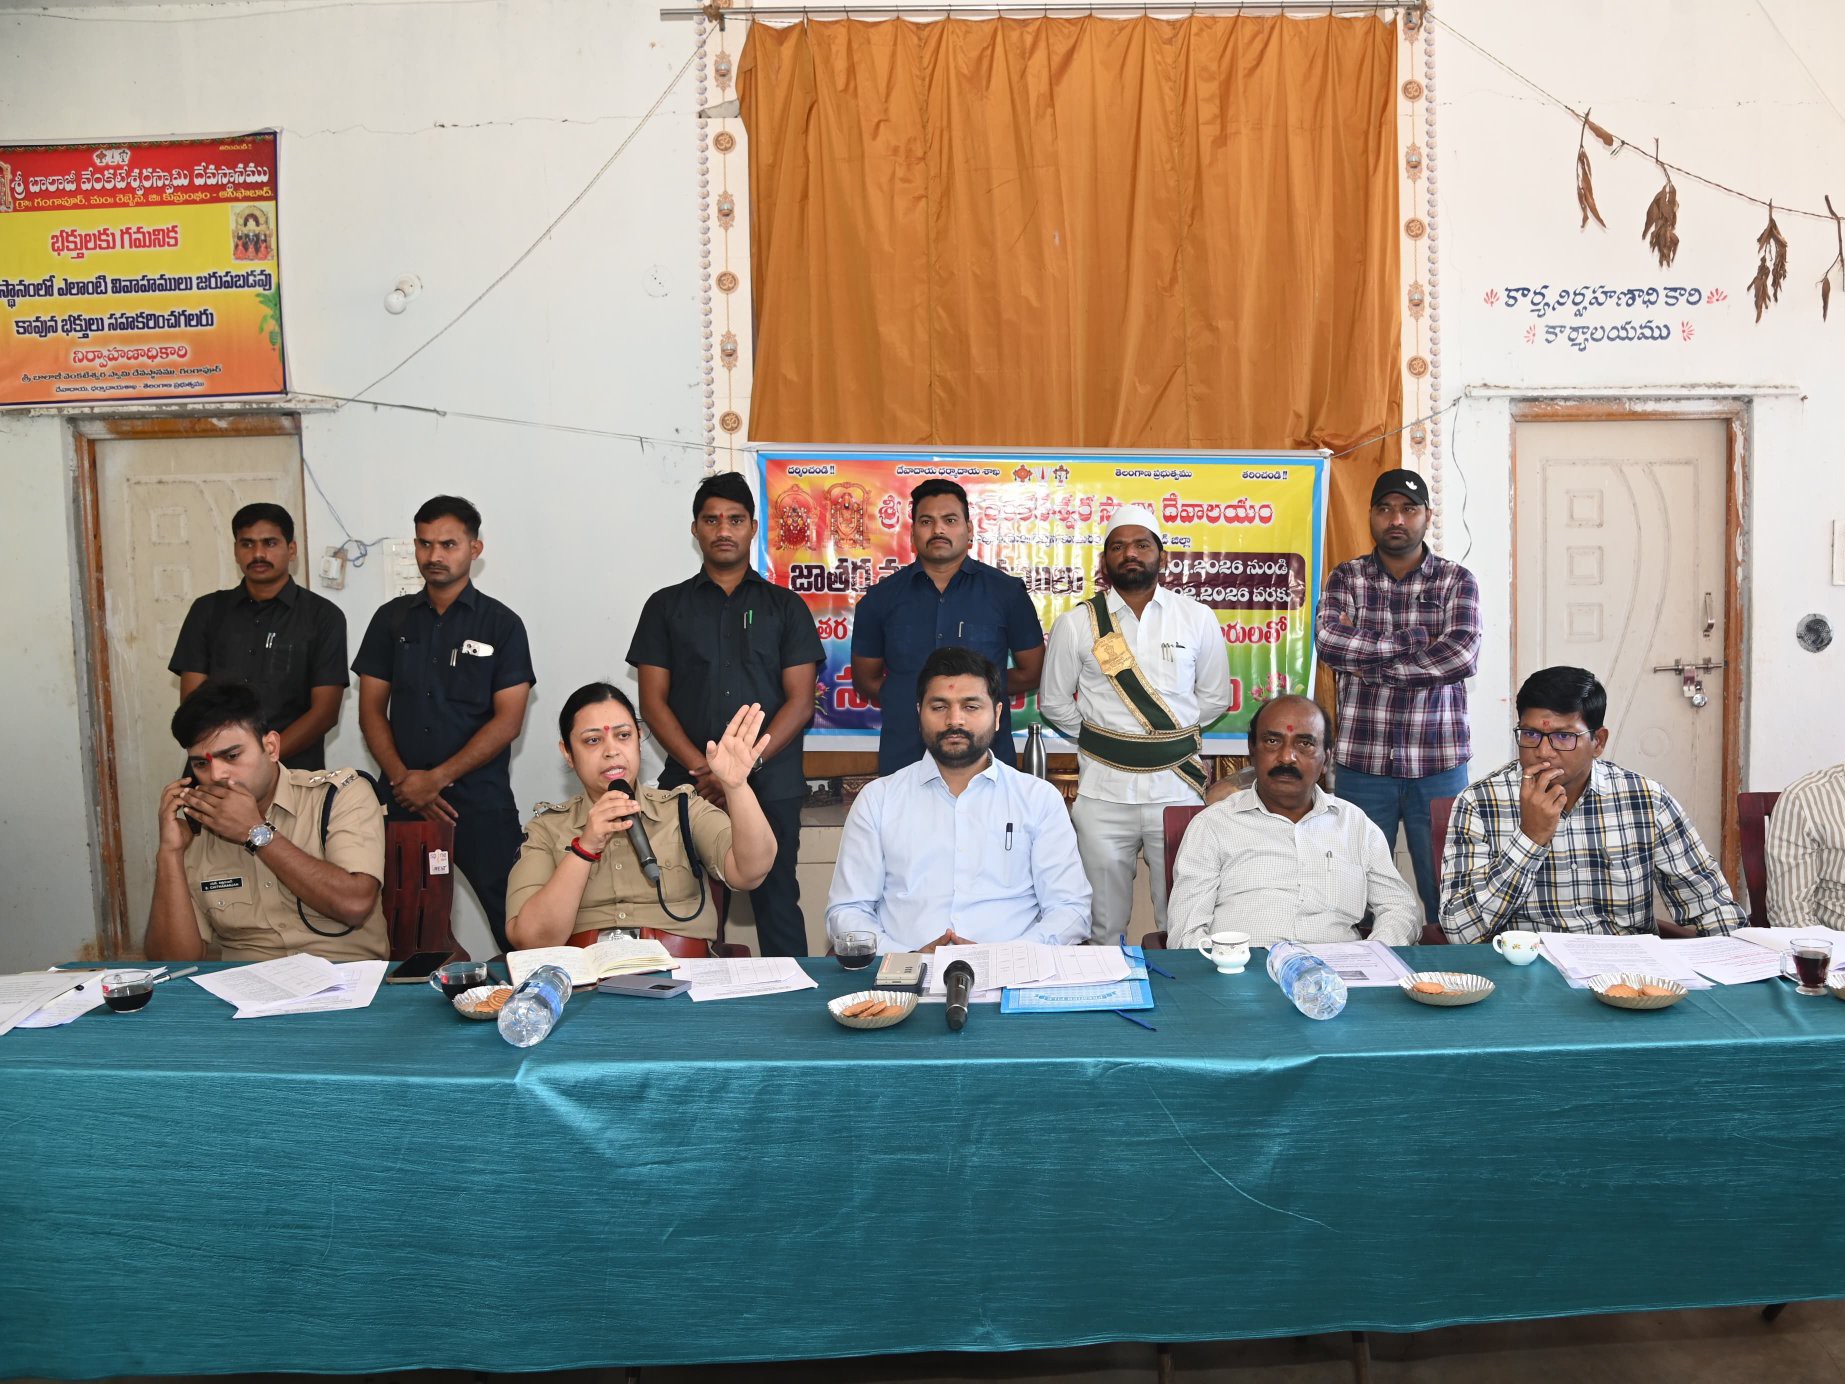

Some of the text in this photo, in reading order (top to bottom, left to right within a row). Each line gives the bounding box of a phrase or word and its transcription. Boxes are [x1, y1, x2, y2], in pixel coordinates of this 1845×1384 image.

[11, 171, 25, 199] శ్రీ
[29, 170, 77, 193] బాలాజీ
[50, 225, 179, 260] భక్తులకు గమనిక
[0, 274, 55, 309] స్థానంలో
[57, 274, 108, 297] ఎలాంటి
[111, 274, 192, 294] వివాహములు
[14, 315, 58, 338] కావున
[61, 313, 104, 339] భక్తులు
[1544, 319, 1671, 352] కార్యాలయము
[879, 494, 902, 530] శ్రీ
[1162, 492, 1275, 526] దేవాలయం
[1246, 558, 1288, 576] నుండి
